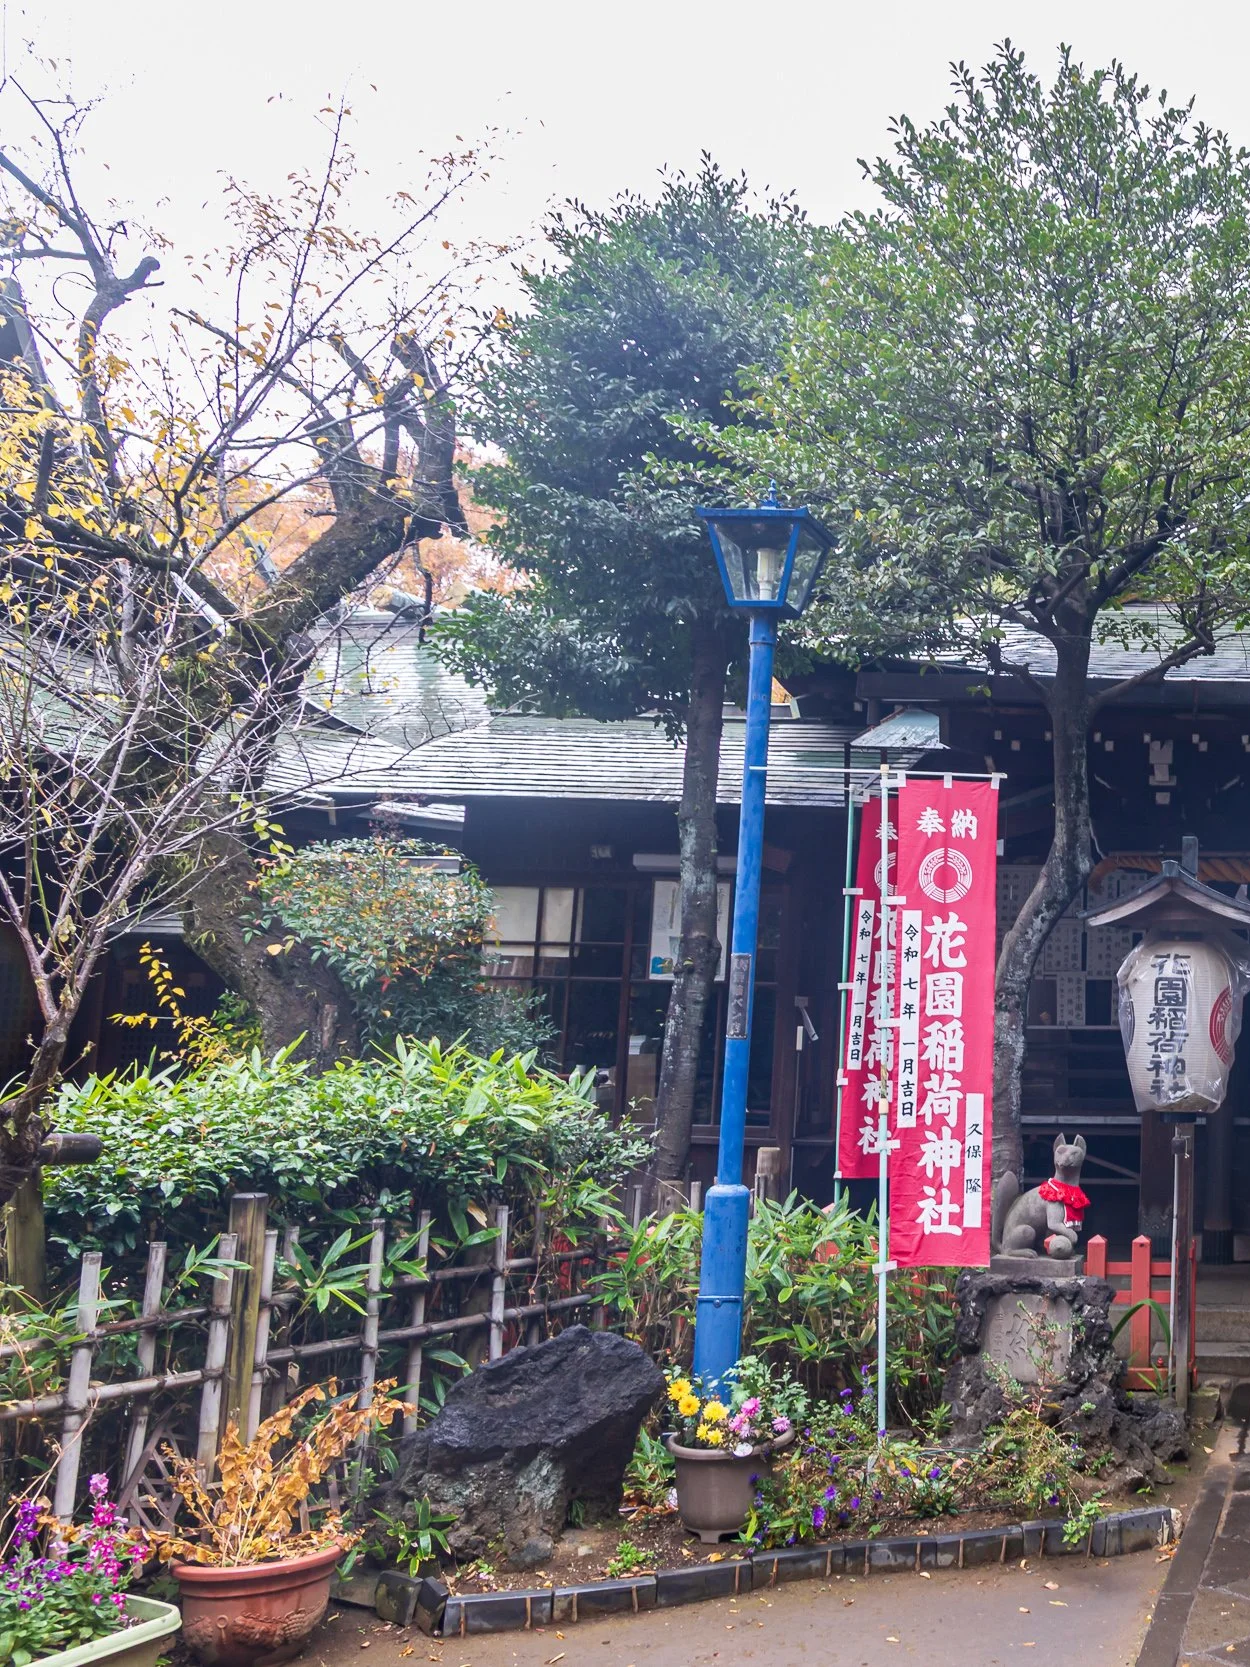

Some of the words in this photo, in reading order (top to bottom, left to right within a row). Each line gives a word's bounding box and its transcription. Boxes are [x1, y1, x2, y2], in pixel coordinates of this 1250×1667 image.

[916, 806, 978, 839] 奉納
[916, 911, 968, 1237] 花園稲荷神社
[1146, 953, 1191, 1102] 花園稲荷神社
